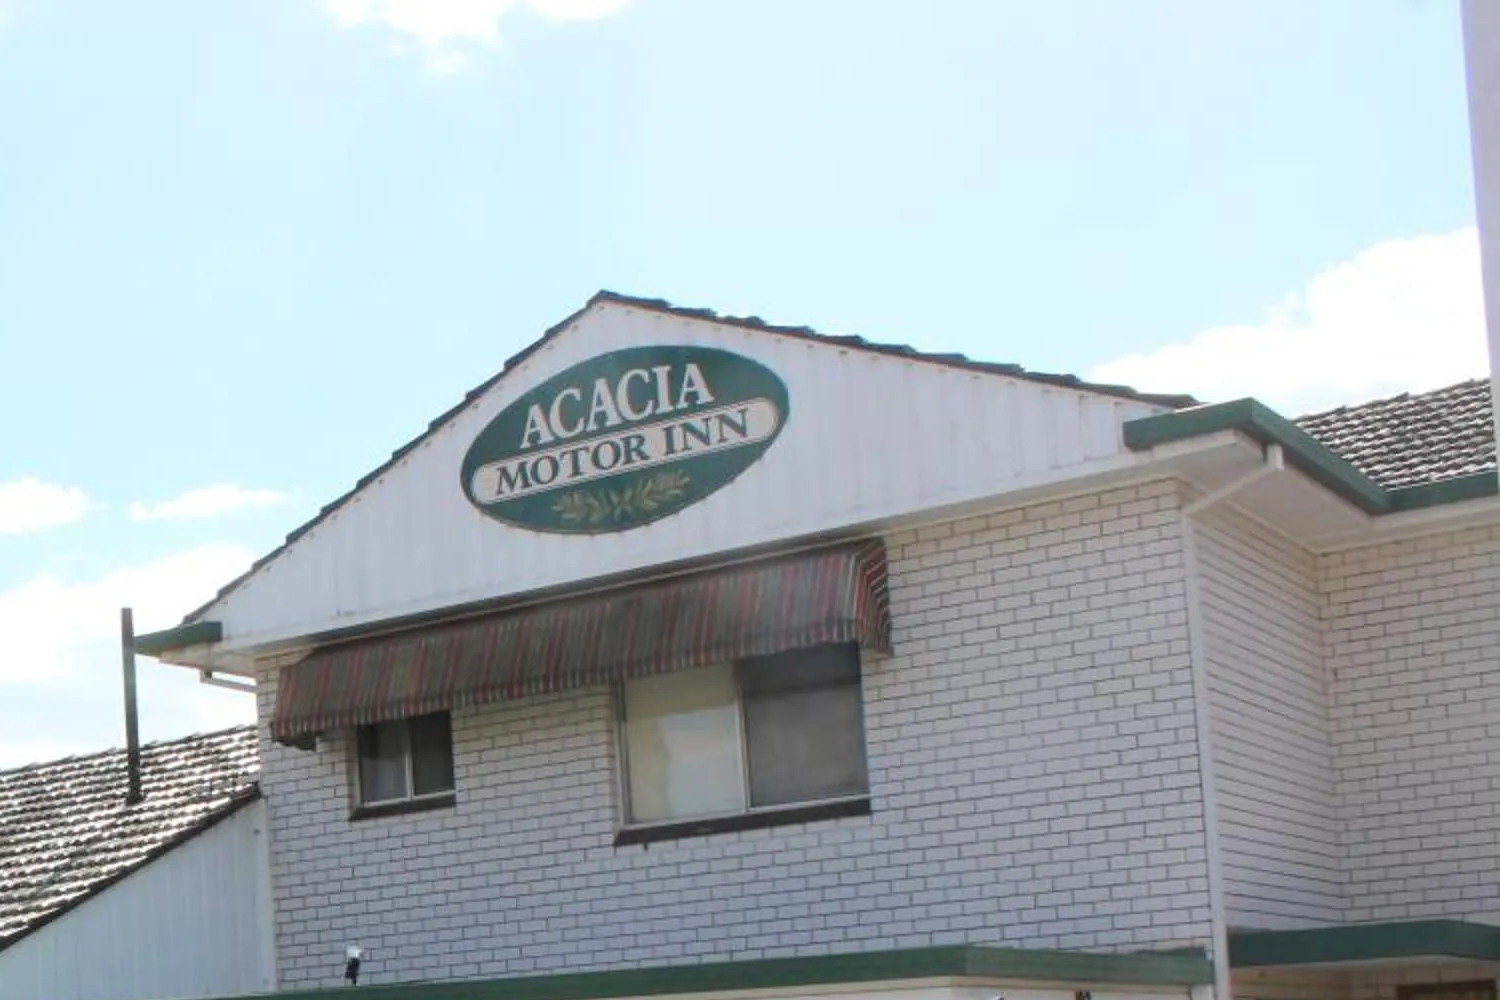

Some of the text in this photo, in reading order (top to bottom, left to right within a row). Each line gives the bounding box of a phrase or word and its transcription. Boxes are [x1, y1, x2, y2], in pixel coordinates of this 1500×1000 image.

[519, 362, 715, 449] ACACIA
[495, 408, 748, 497] MOTOR INN
